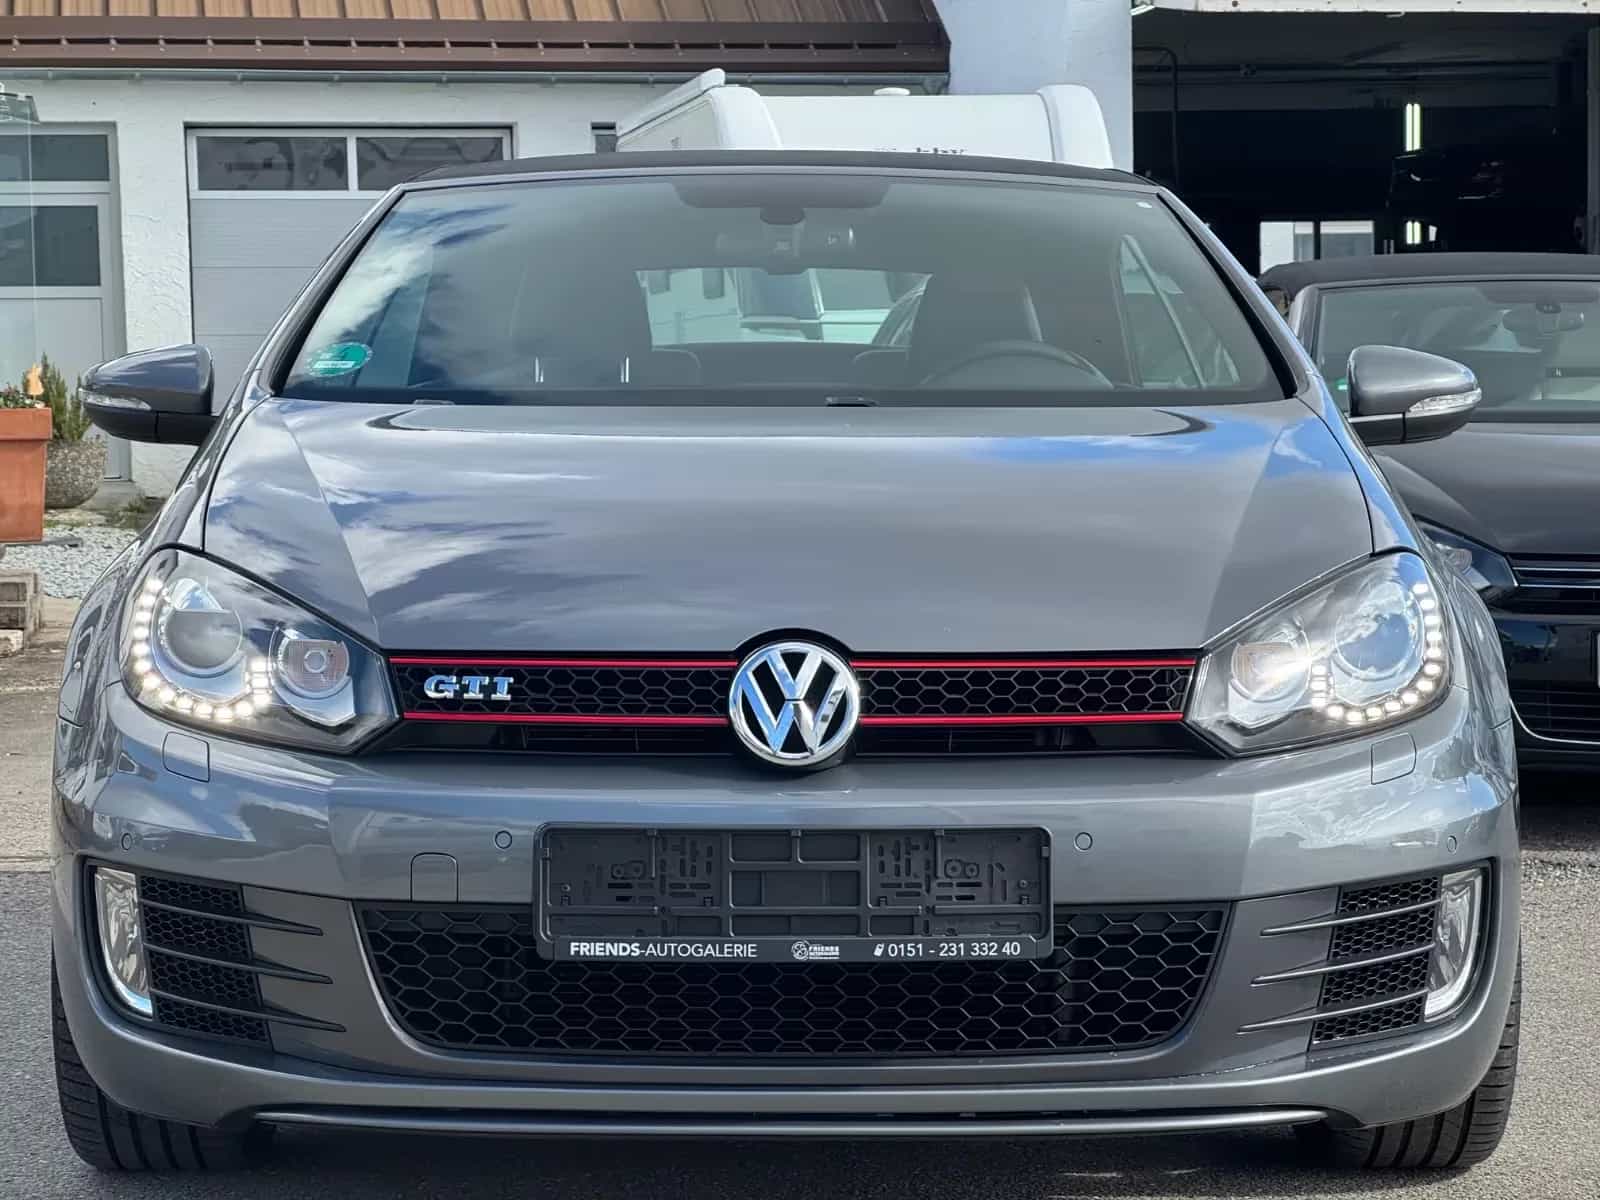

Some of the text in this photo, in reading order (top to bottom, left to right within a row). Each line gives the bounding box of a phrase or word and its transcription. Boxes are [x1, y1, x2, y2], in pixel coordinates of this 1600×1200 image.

[423, 674, 514, 701] GTI
[731, 643, 858, 763] VW
[569, 941, 758, 958] FRIENDS-AUTOGALERIE
[888, 943, 923, 957] 0151
[939, 943, 965, 956] 231
[971, 942, 998, 956] 332
[1002, 941, 1021, 956] 40
